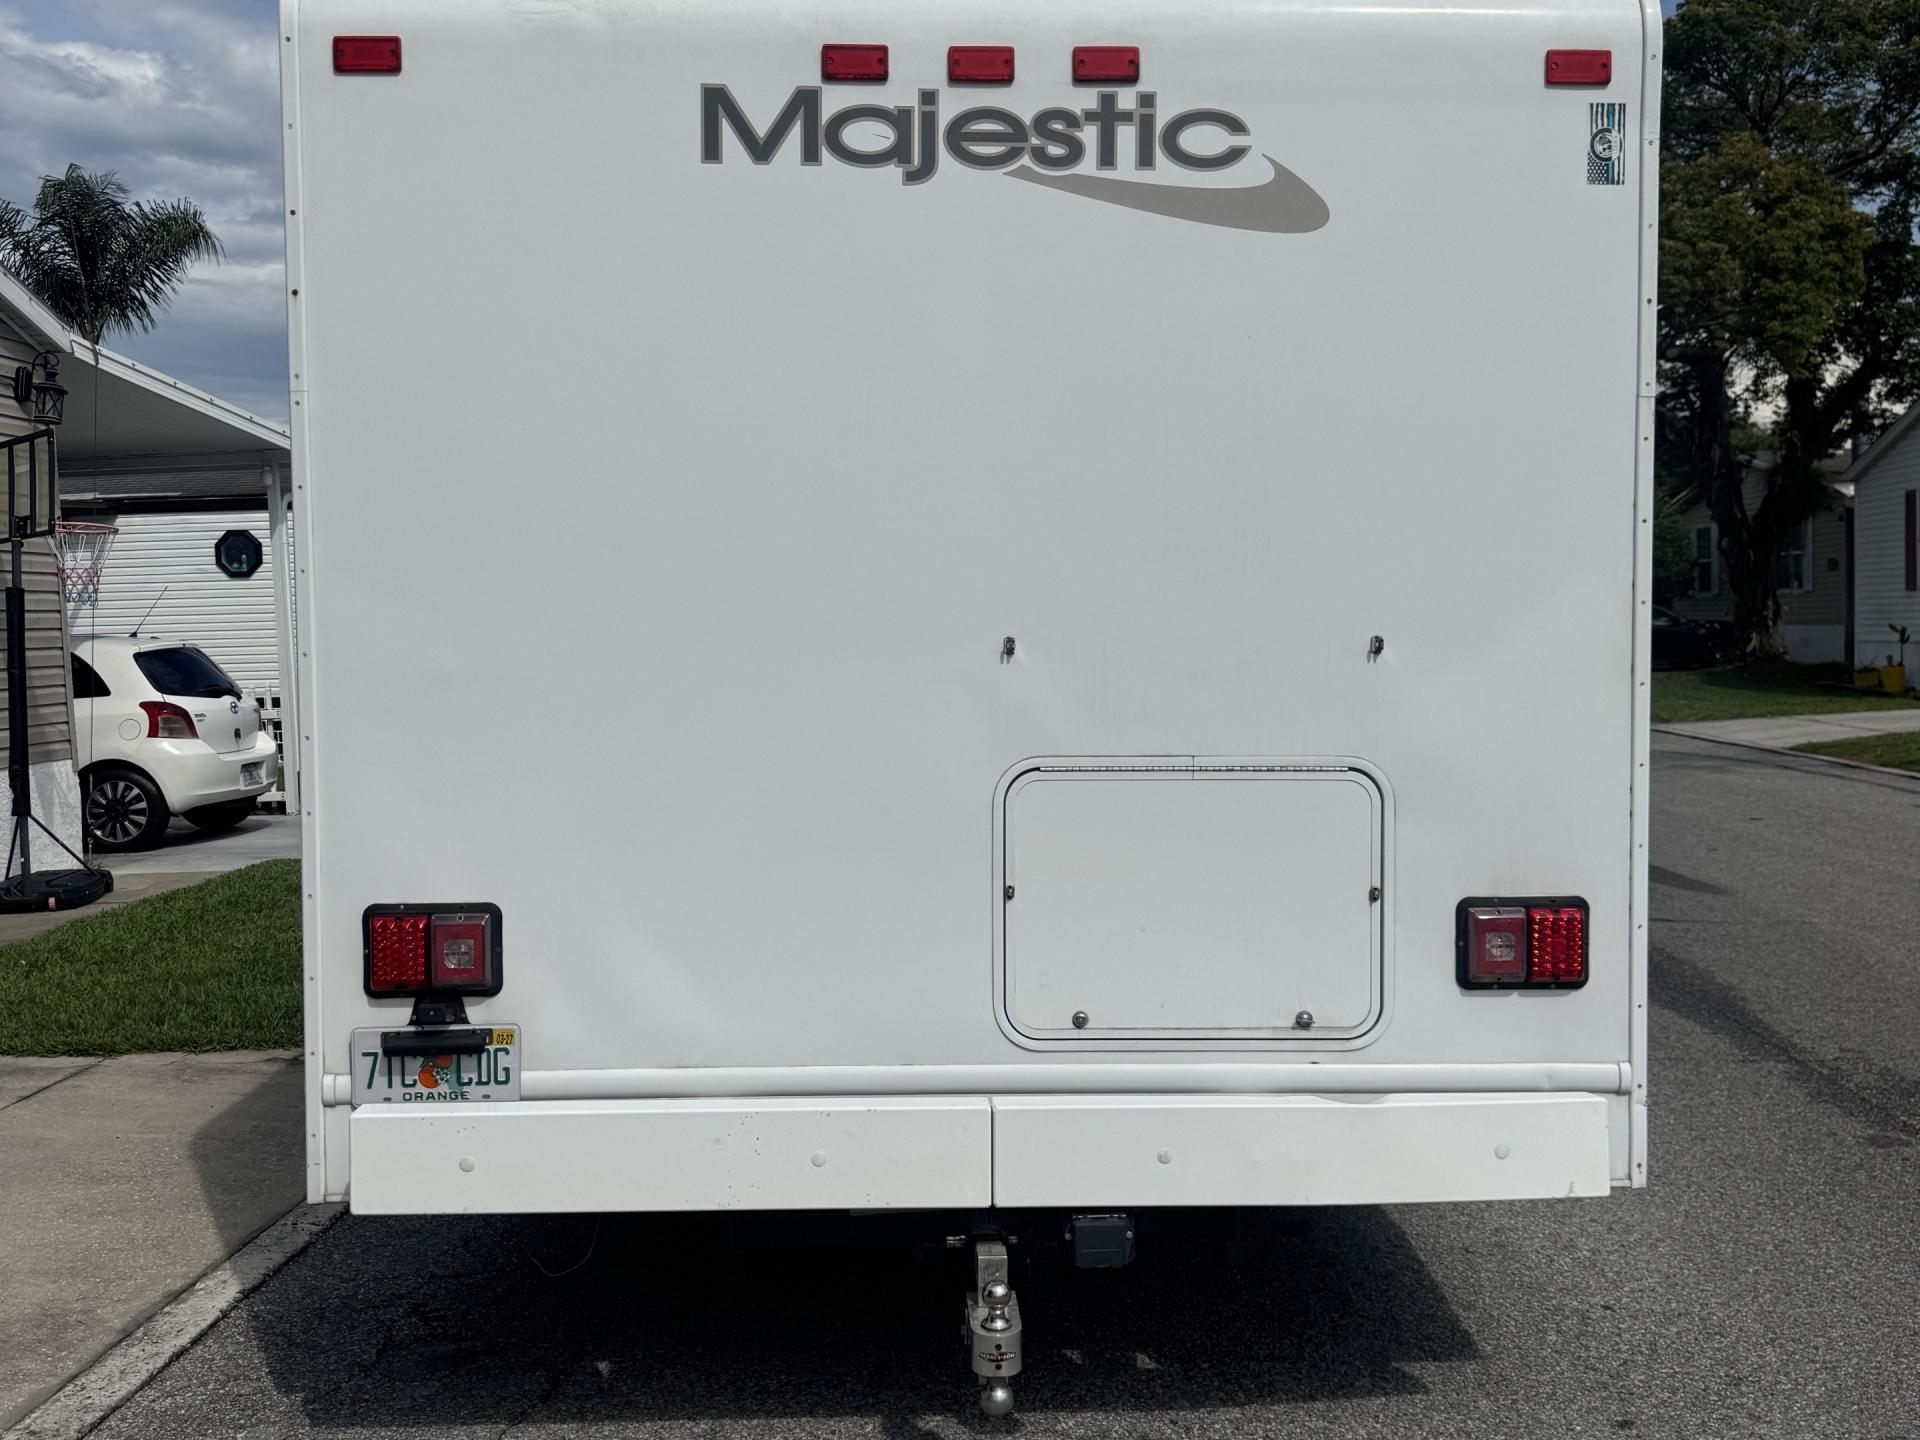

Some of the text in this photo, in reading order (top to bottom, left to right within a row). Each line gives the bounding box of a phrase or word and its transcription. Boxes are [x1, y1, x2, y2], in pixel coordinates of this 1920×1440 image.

[701, 83, 1251, 186] Majestic
[496, 1033, 514, 1045] 03-27
[457, 1047, 511, 1086] CDG
[402, 1091, 470, 1101] ORANGE
